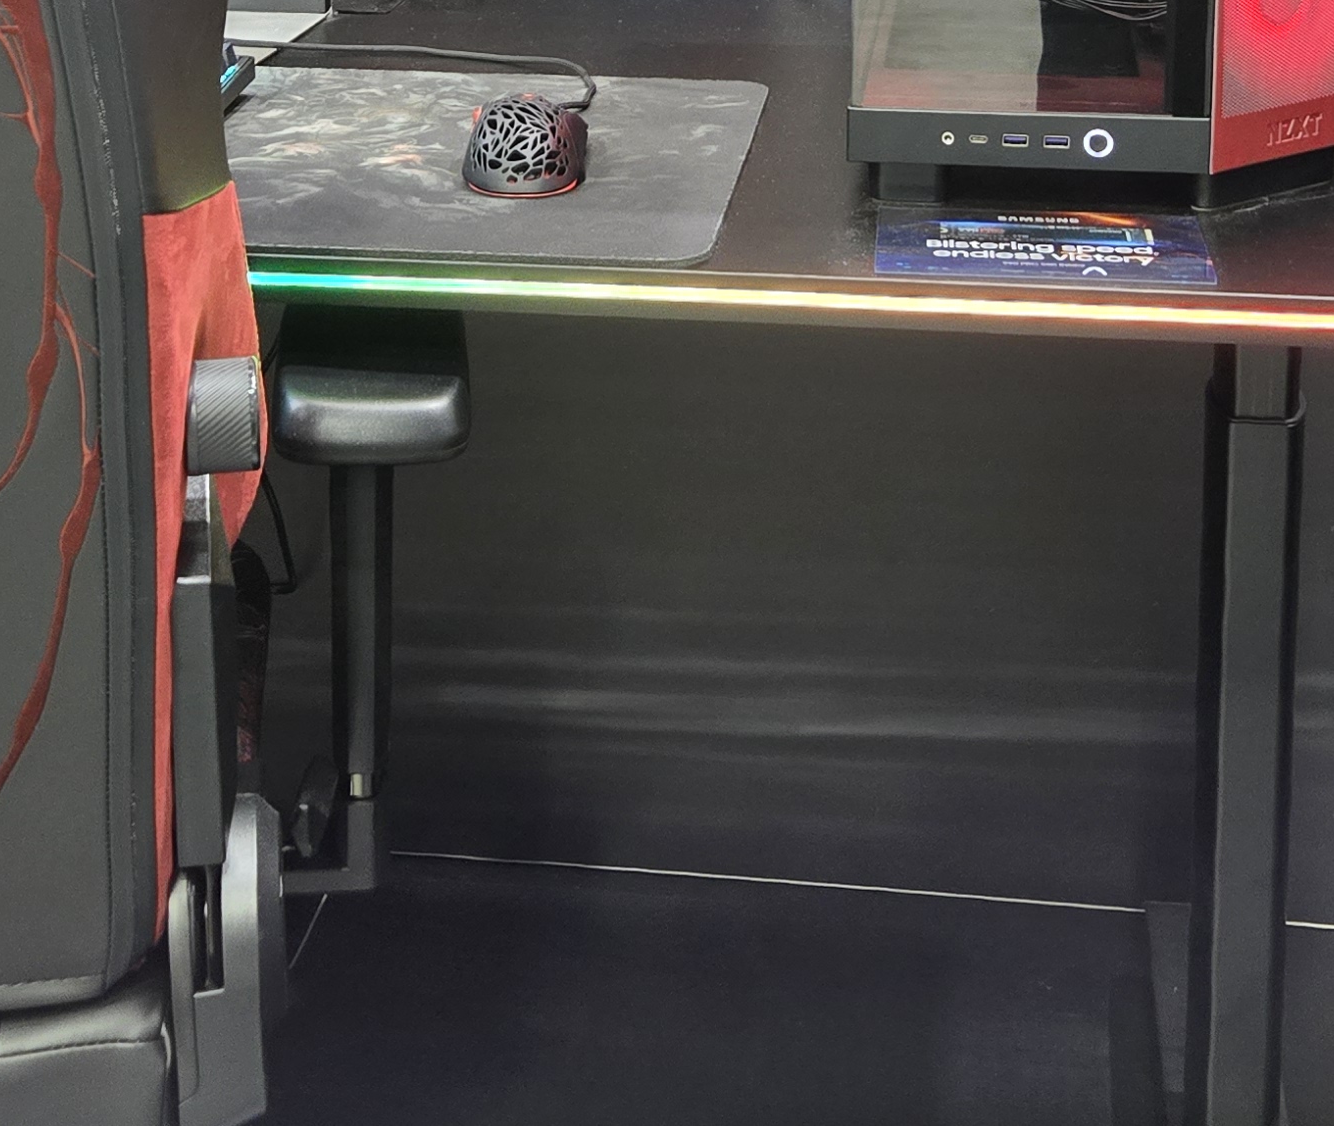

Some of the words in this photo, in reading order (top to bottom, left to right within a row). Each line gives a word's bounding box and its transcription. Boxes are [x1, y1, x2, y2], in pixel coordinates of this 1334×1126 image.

[1266, 113, 1323, 146] NZXT
[997, 215, 1079, 224] SAMSUNG
[925, 239, 1054, 254] Blistering
[933, 249, 1045, 260] endless
[1051, 253, 1154, 266] victory
